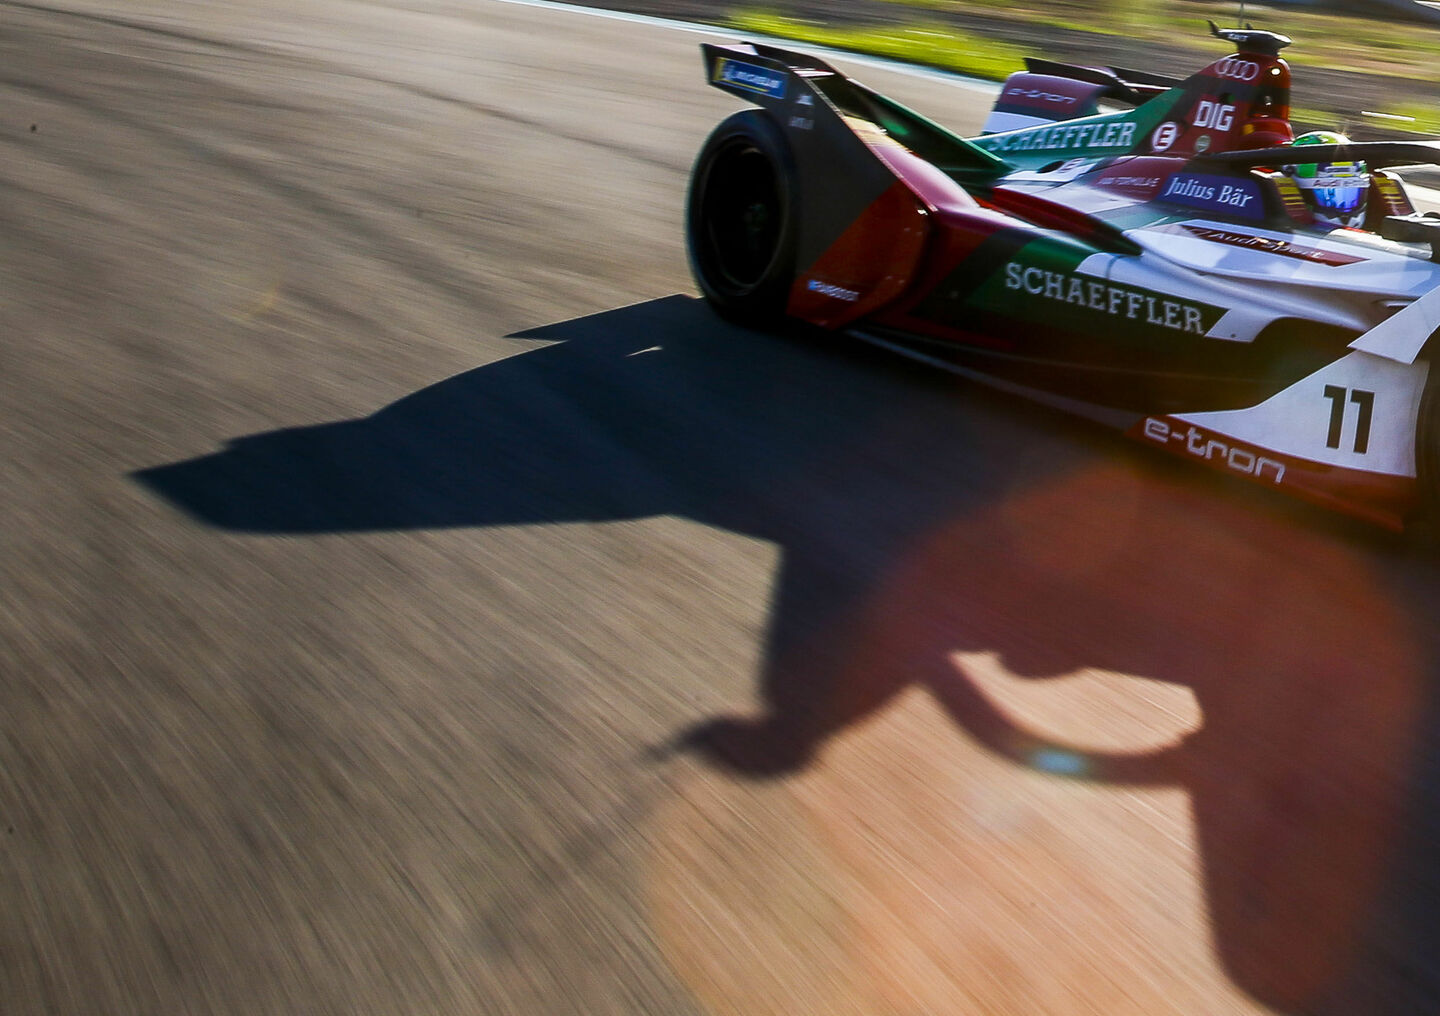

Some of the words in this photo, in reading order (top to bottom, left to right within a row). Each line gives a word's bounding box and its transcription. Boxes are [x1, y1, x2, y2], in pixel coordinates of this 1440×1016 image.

[986, 121, 1138, 152] SCHAEFFLER
[1192, 100, 1236, 132] DIG
[1165, 176, 1216, 200] Julius
[1217, 184, 1254, 208] Bär
[1005, 261, 1205, 335] SCHAEFFLER
[1323, 383, 1375, 456] 11
[1144, 415, 1286, 484] e-tron
